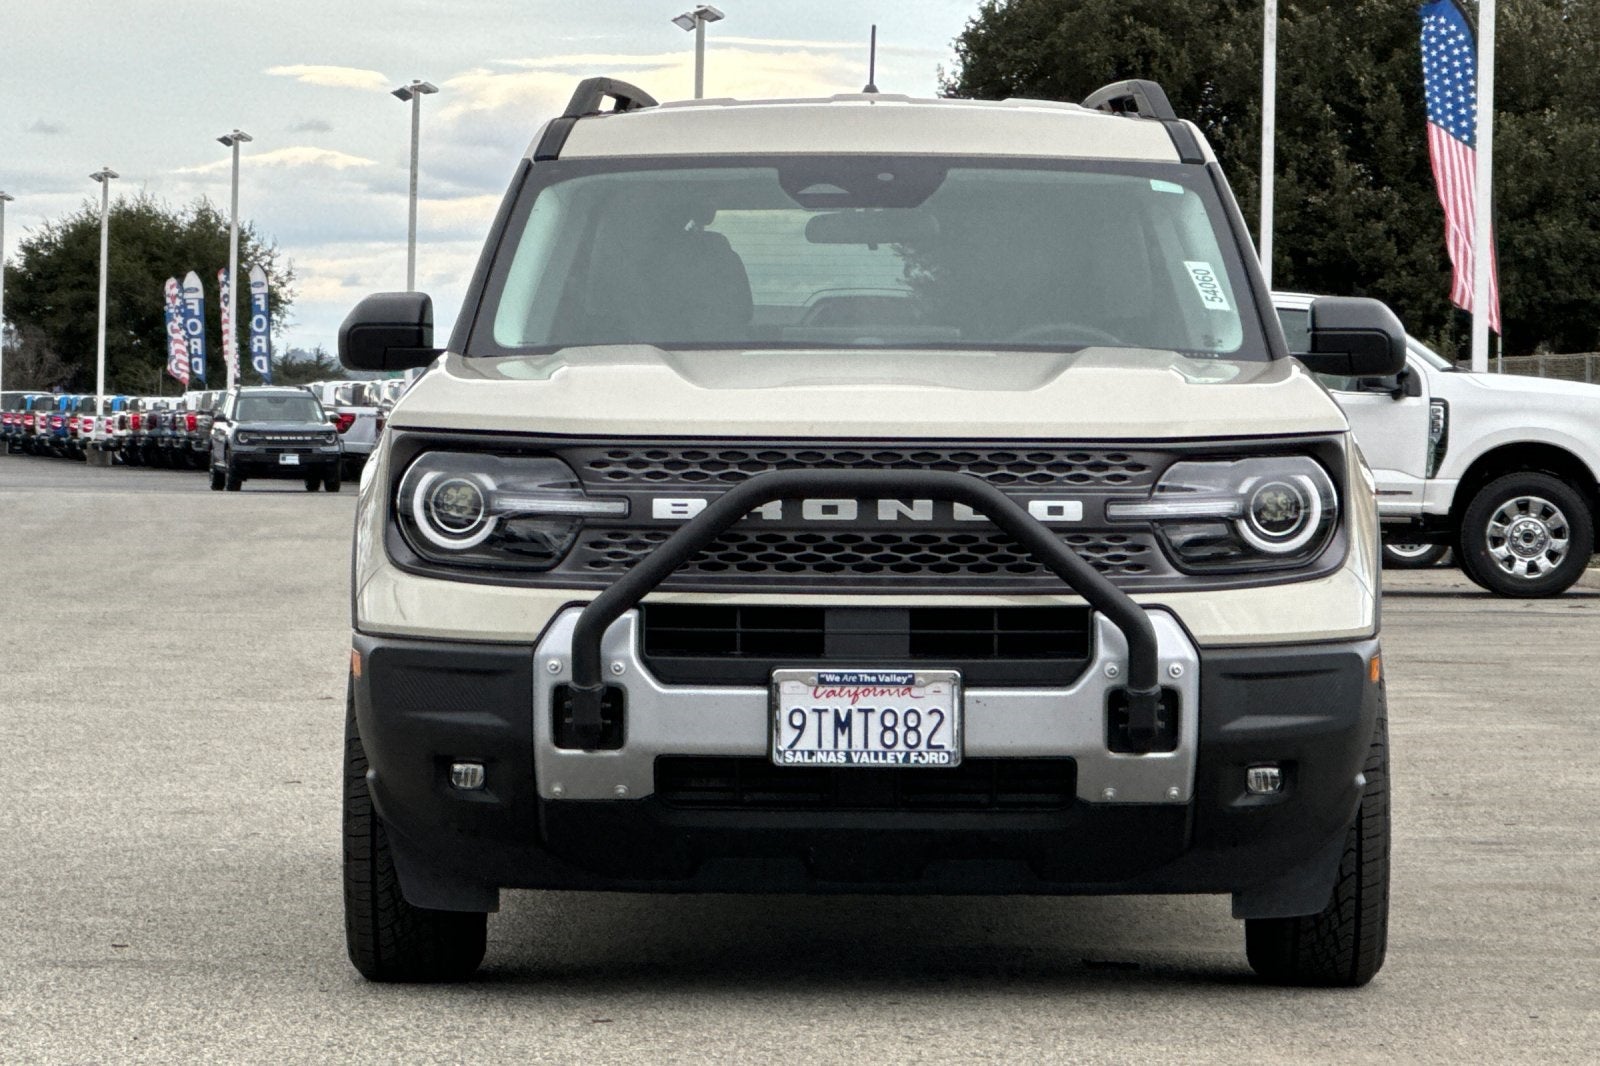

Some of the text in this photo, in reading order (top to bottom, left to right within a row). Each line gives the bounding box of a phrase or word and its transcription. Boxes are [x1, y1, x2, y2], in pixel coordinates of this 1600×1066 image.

[842, 674, 857, 682] Are
[859, 674, 877, 682] The
[787, 708, 945, 750] 9TMT882
[851, 751, 906, 763] VALLEY
[910, 751, 949, 764] FORD
